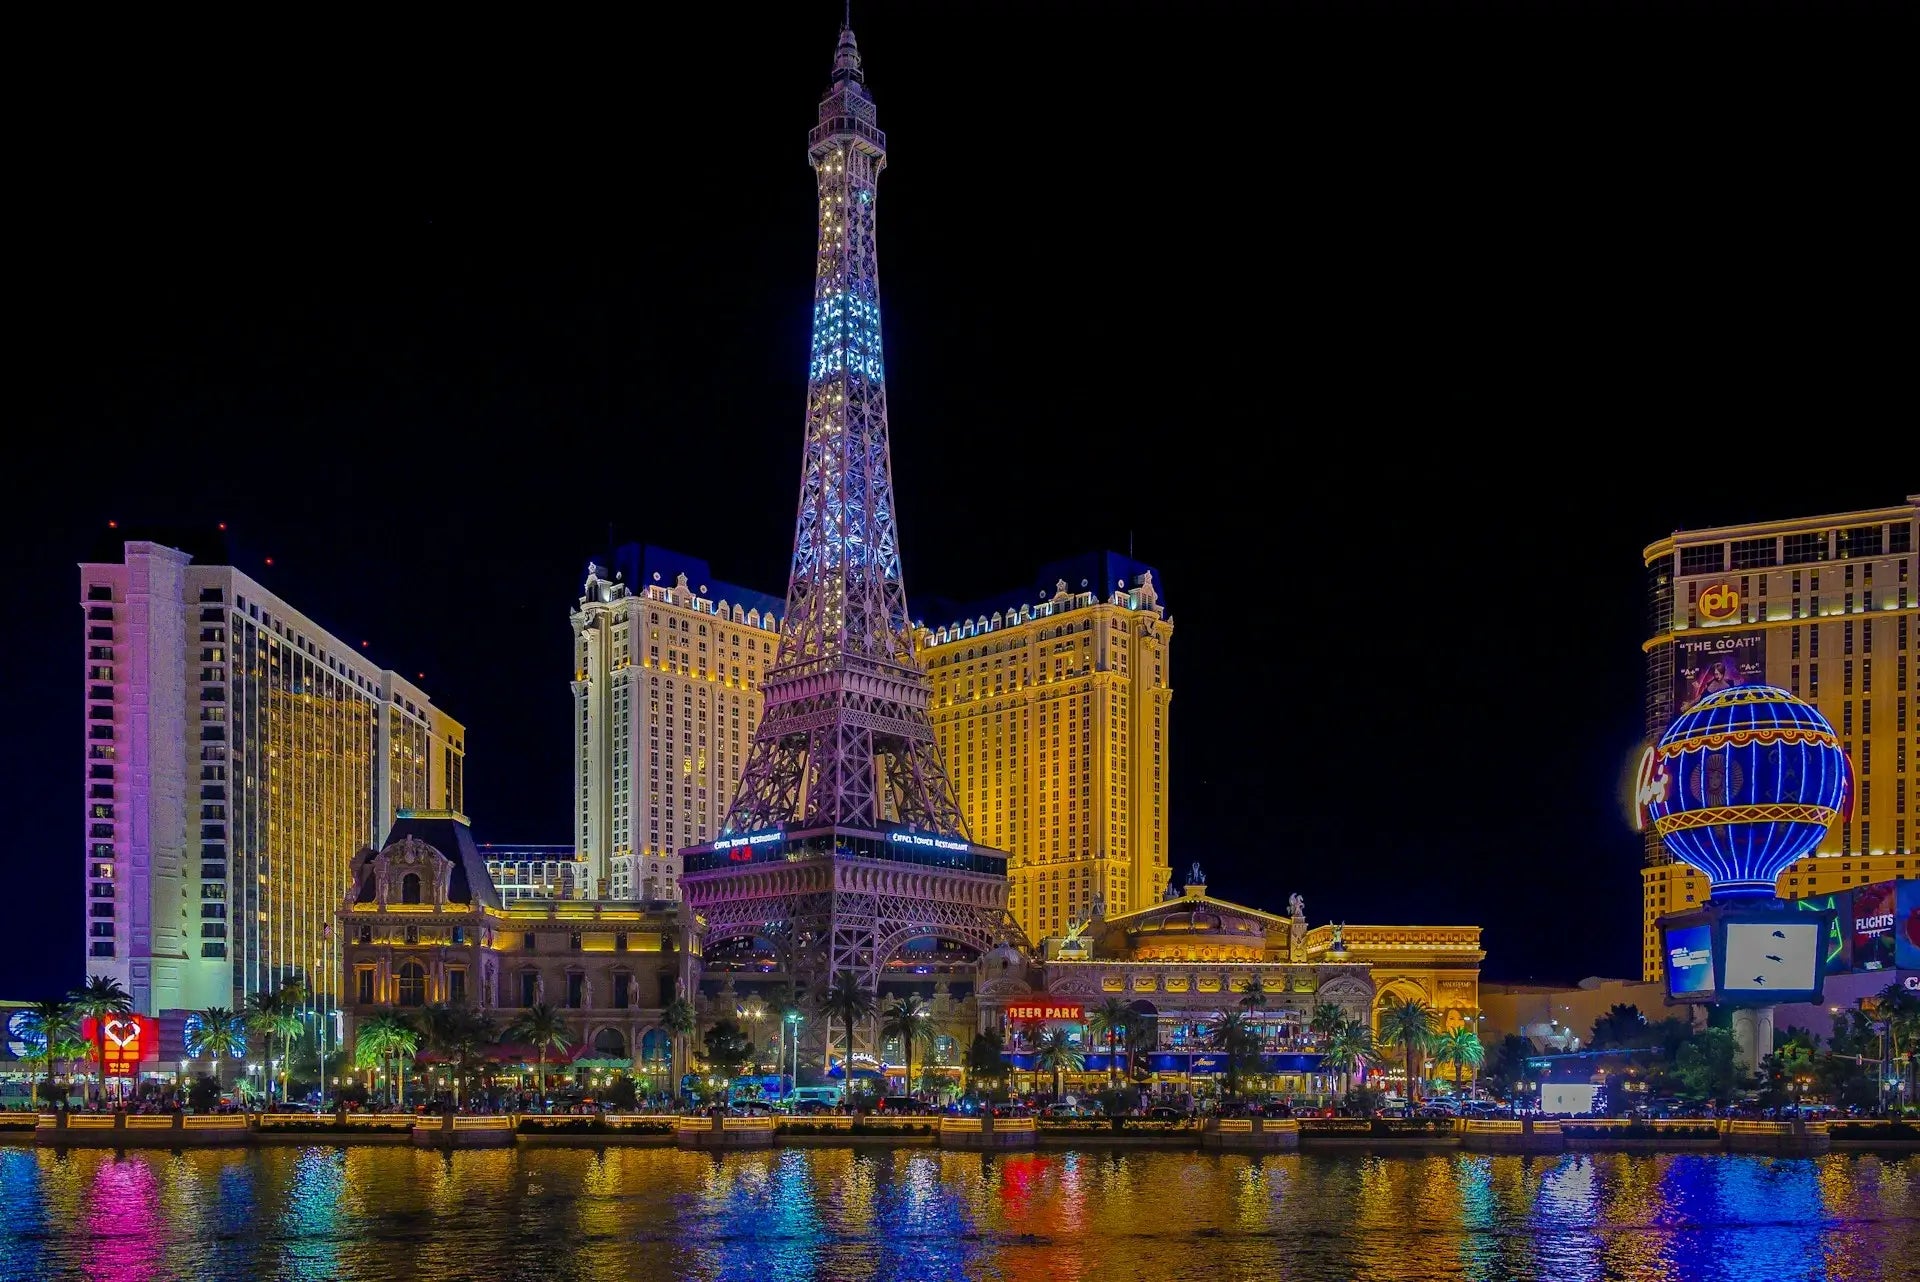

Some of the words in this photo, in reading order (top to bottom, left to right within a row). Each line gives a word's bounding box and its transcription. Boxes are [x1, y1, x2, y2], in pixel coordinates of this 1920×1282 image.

[1704, 584, 1738, 617] ph
[1856, 914, 1894, 930] FLIGHTS
[1009, 1007, 1042, 1018] BEER
[1045, 1007, 1079, 1018] PARK
